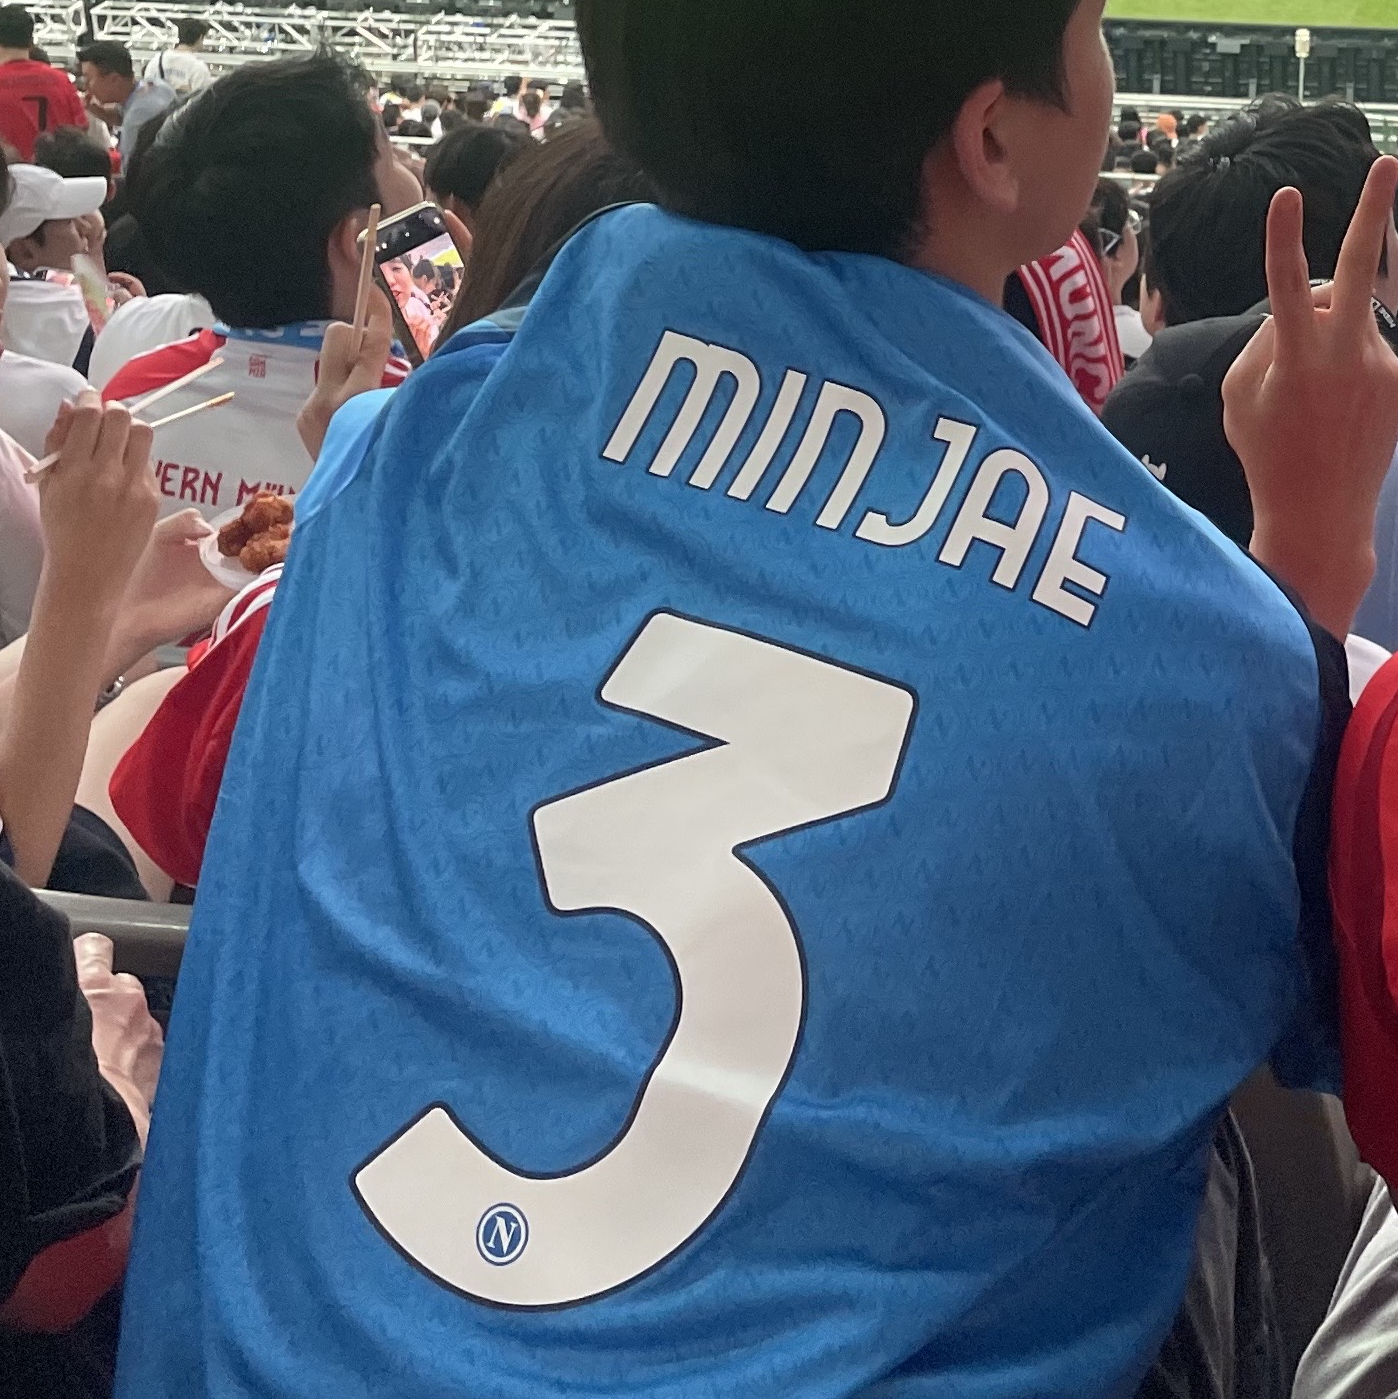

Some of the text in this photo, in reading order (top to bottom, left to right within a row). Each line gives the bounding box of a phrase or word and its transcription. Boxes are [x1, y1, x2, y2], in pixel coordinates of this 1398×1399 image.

[22, 96, 48, 132] 7
[601, 328, 1127, 628] MINJAE
[351, 607, 919, 1312] 3
[486, 1214, 519, 1256] N
